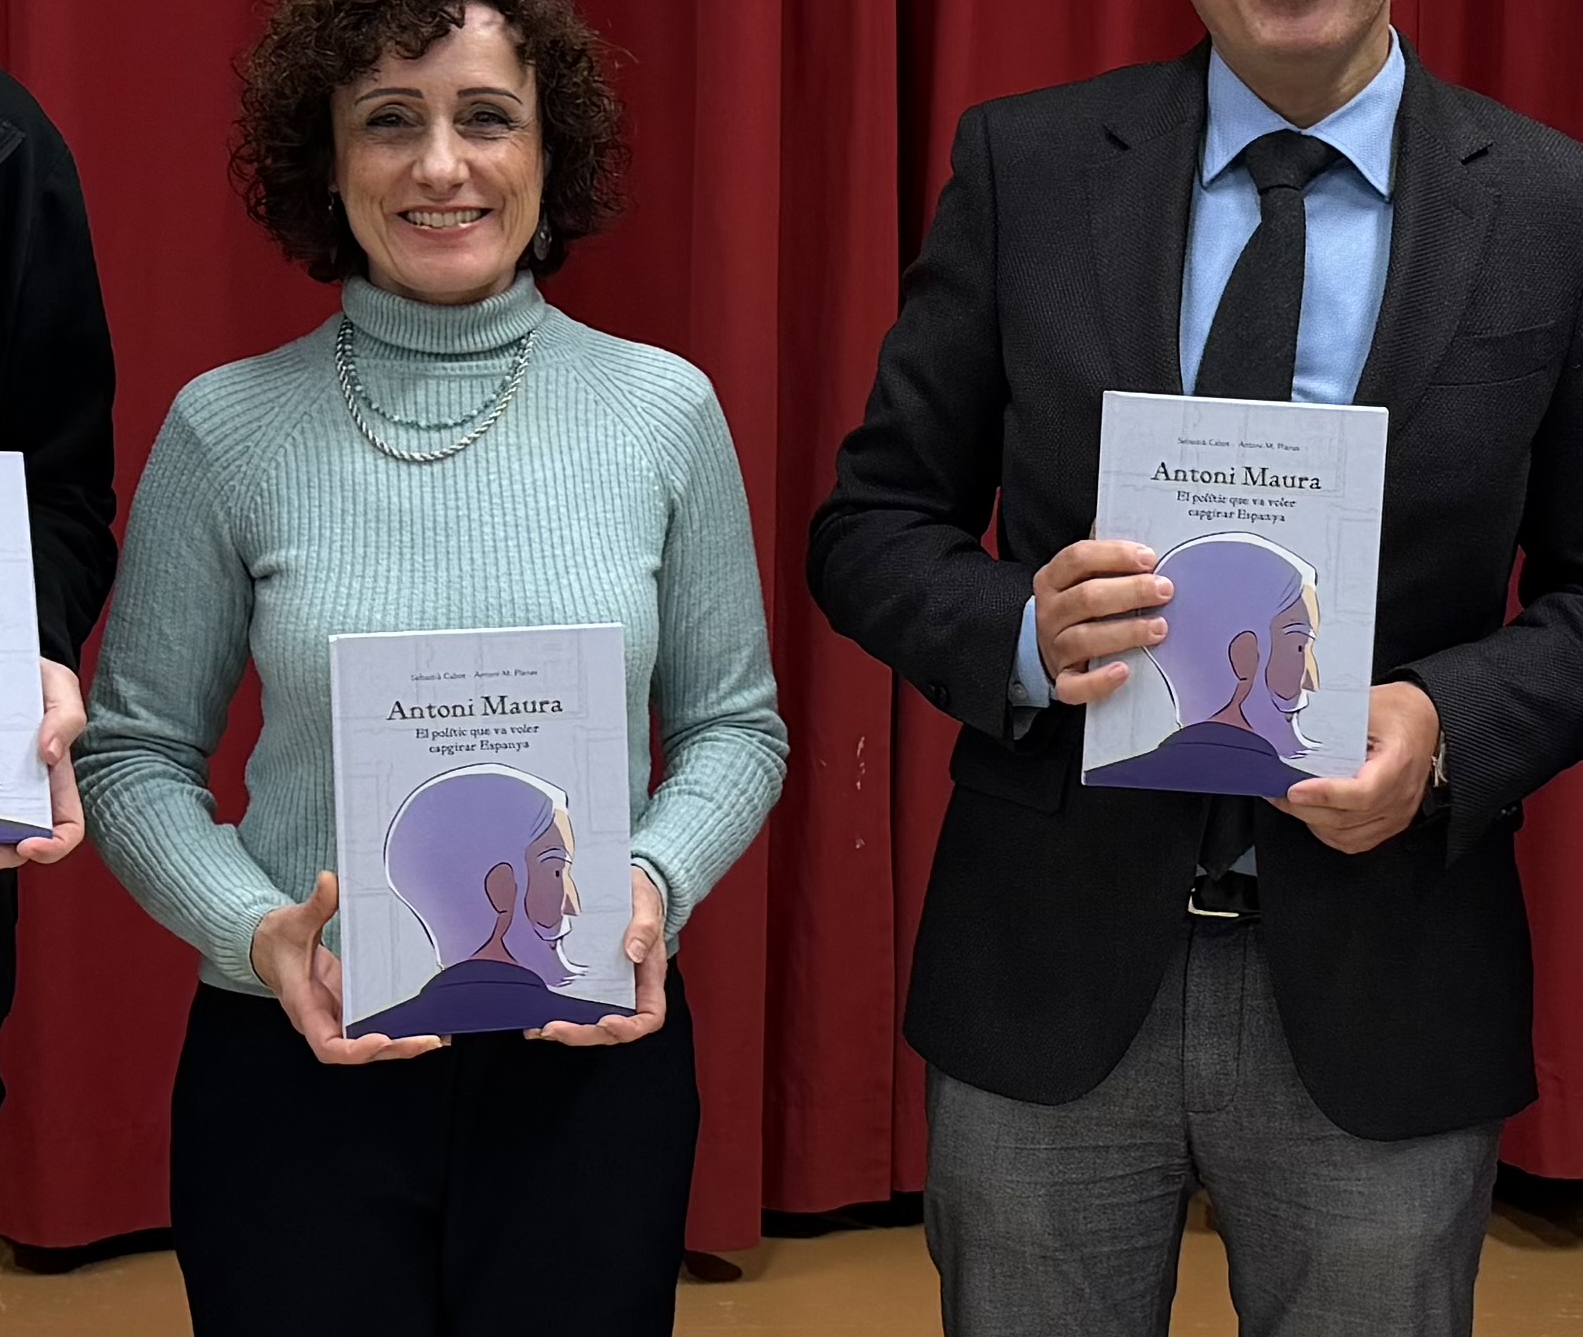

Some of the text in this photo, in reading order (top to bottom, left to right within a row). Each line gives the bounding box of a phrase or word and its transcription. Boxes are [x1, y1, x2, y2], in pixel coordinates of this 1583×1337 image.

[1151, 462, 1322, 489] Antoni Maura
[1177, 491, 1189, 501] El
[1229, 495, 1249, 507] que
[1252, 498, 1265, 506] va
[1188, 508, 1286, 524] capgirar Espanya
[386, 695, 563, 720] Antoni Maura
[416, 728, 429, 739] El
[431, 728, 467, 741] polític
[470, 728, 490, 740] que
[511, 724, 539, 735] voler
[429, 740, 529, 755] capgirar Espanya
